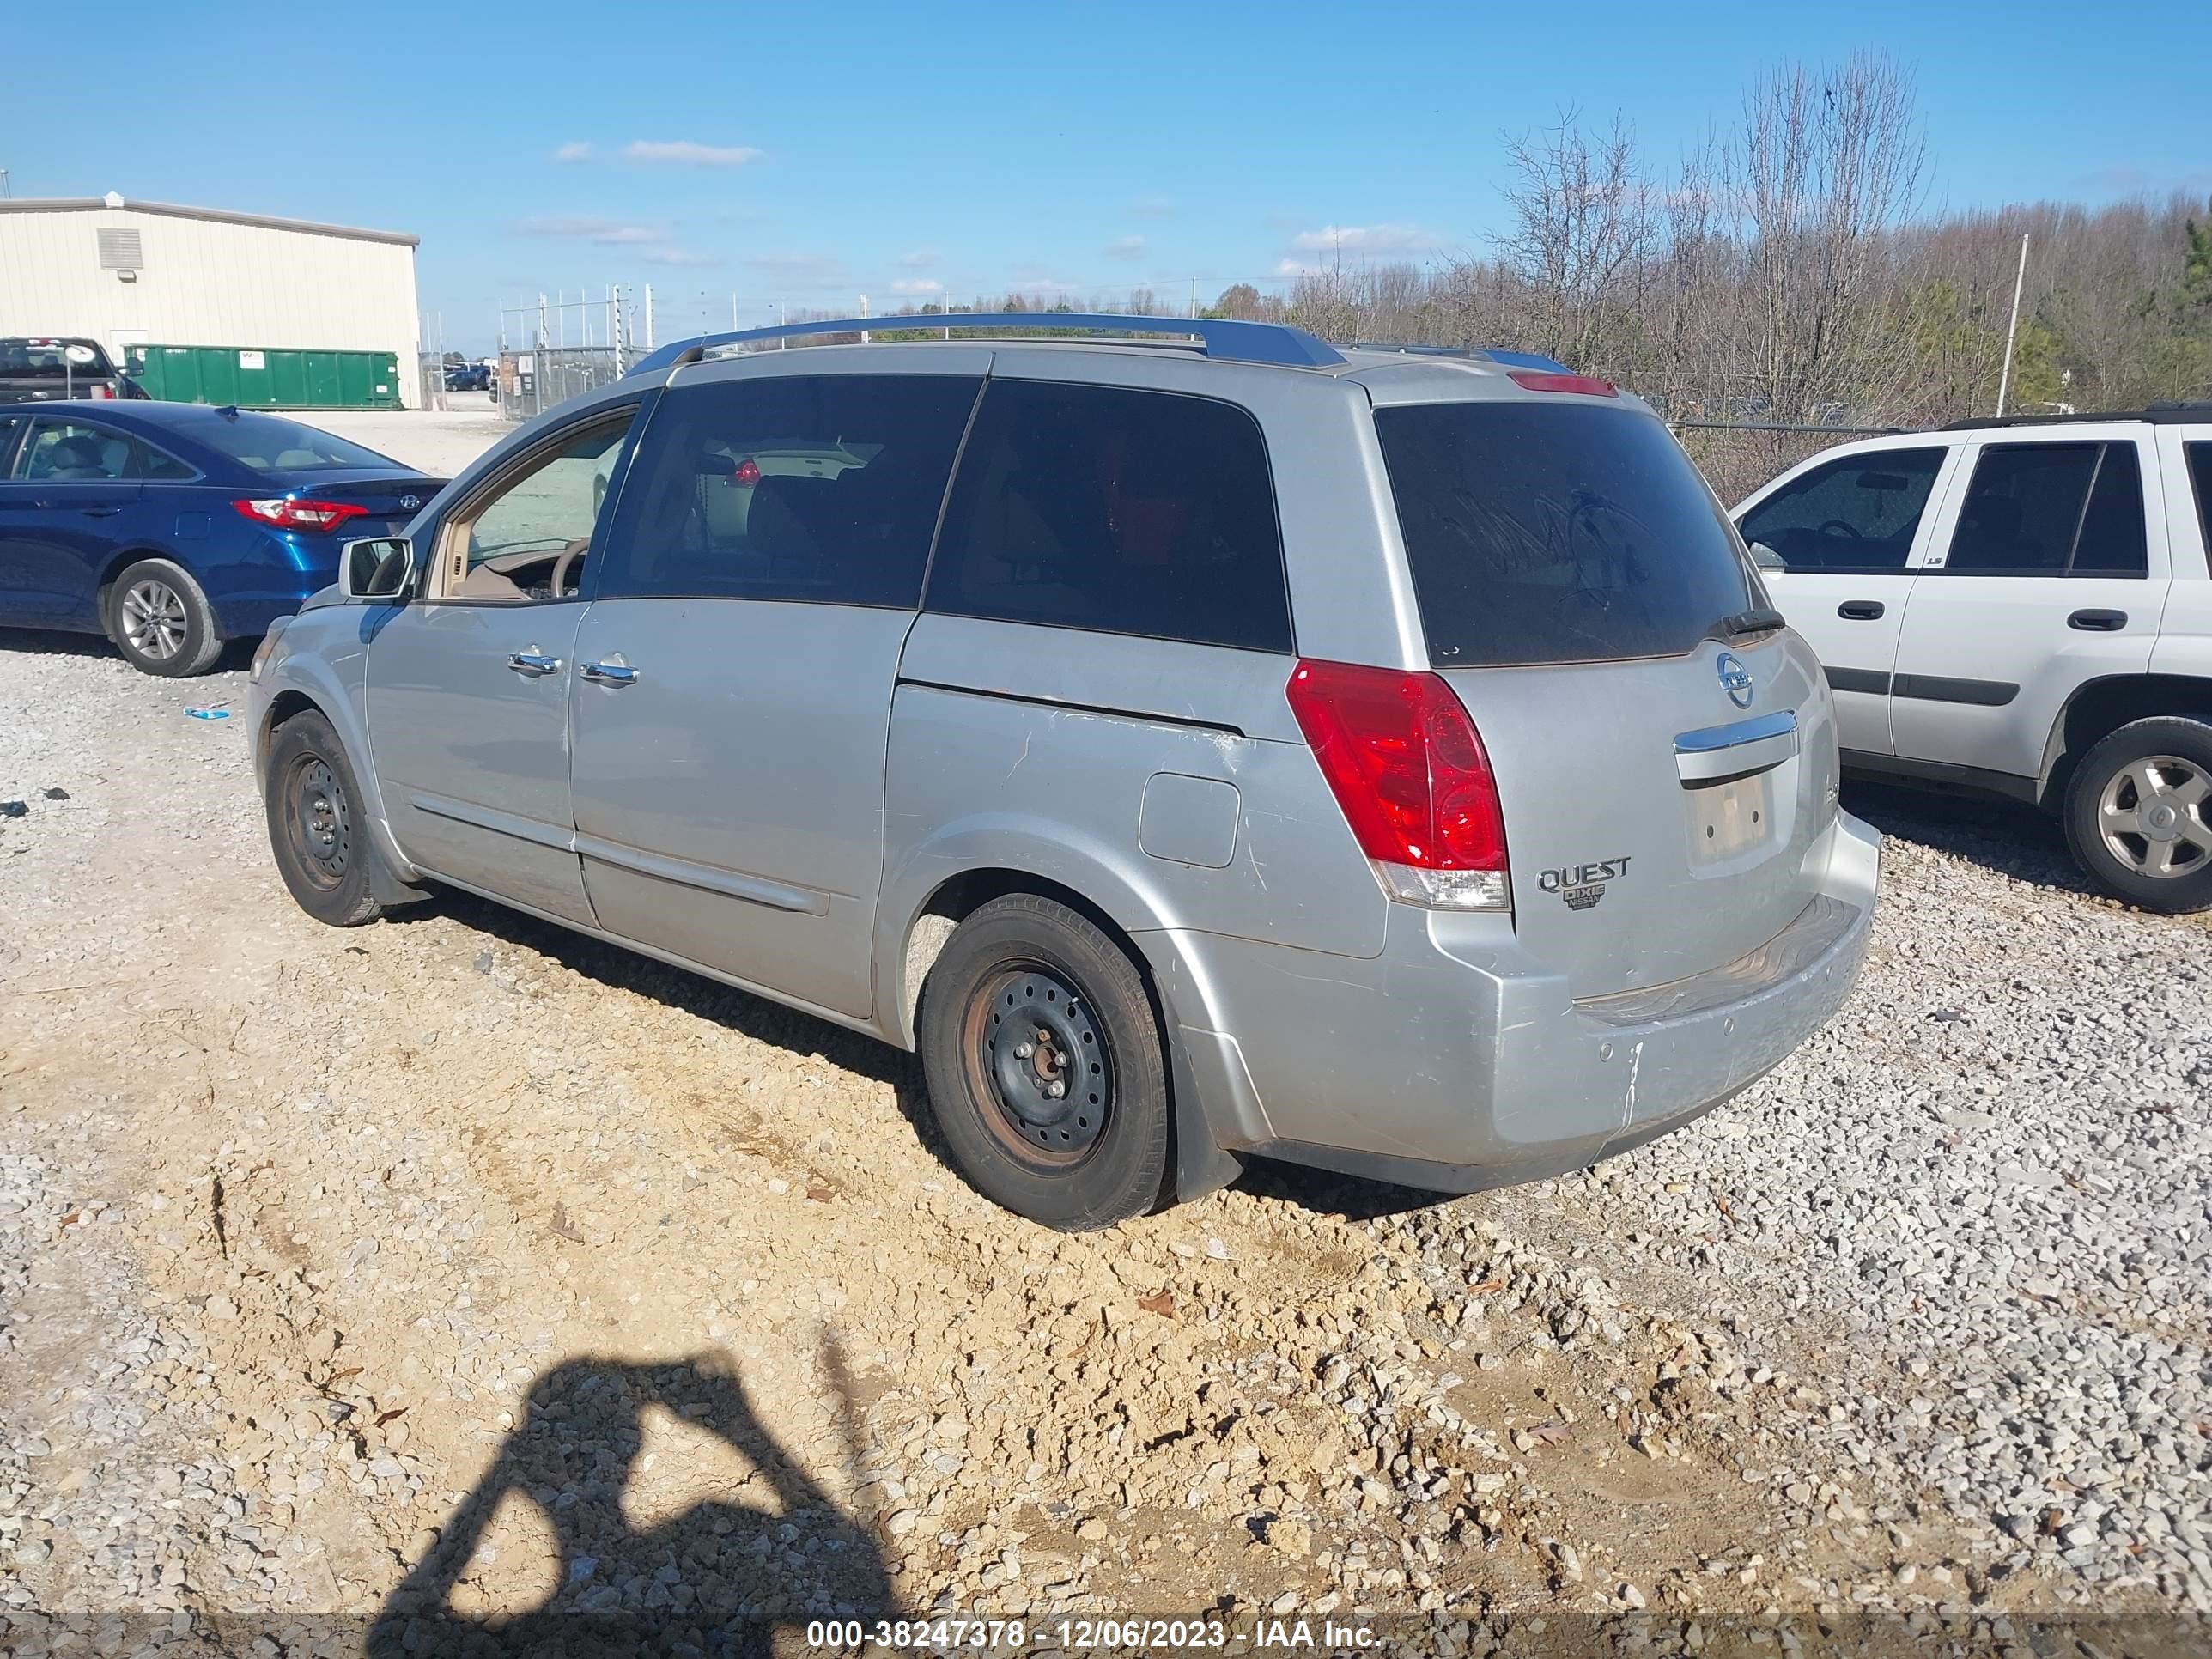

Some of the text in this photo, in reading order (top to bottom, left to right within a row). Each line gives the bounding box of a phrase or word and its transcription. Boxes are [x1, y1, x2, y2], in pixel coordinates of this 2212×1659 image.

[1536, 855, 1632, 894] QUEST
[1564, 885, 1605, 901] DIXIE
[1569, 895, 1601, 908] NISSAN
